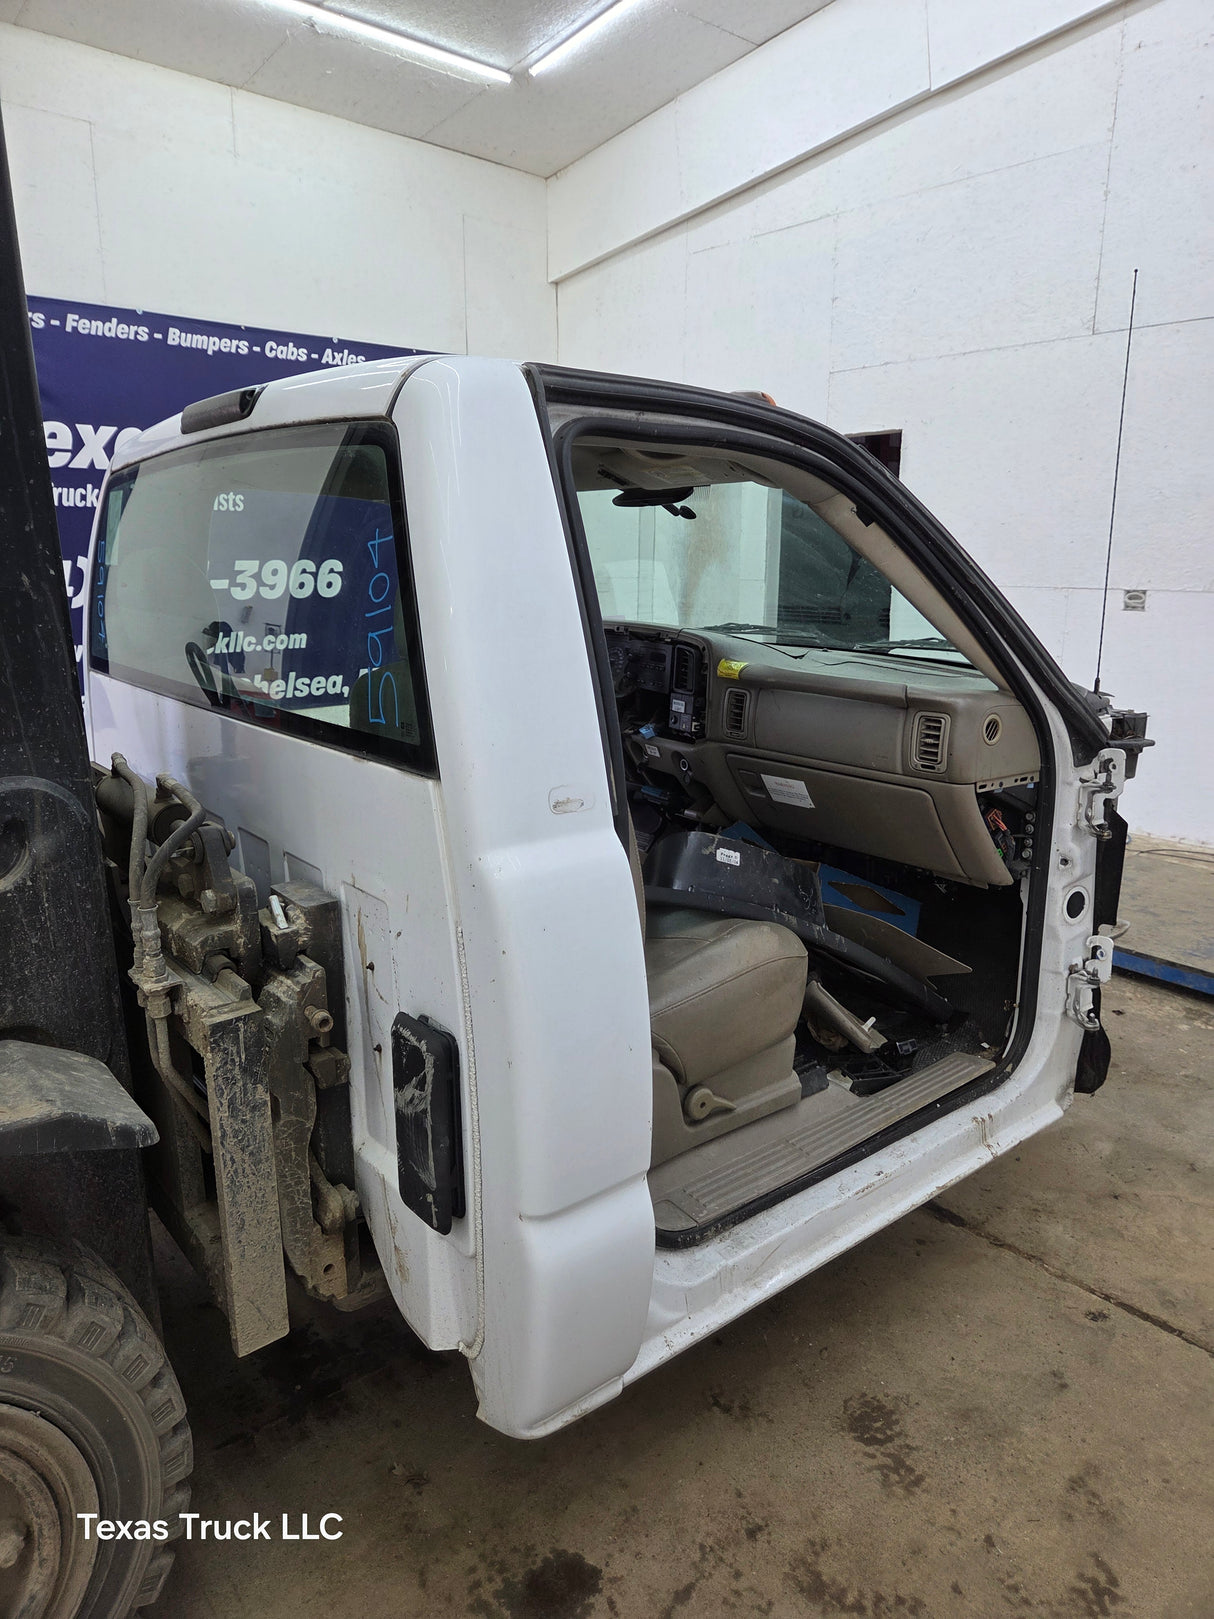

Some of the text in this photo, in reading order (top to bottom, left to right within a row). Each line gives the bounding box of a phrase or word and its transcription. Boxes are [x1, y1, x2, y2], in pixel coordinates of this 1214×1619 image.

[65, 313, 149, 342] Fenders
[167, 327, 249, 355] Bumpers
[265, 341, 308, 362] Cabs
[52, 482, 100, 507] ruck
[365, 528, 398, 727] 59104
[240, 671, 350, 700] helsea,
